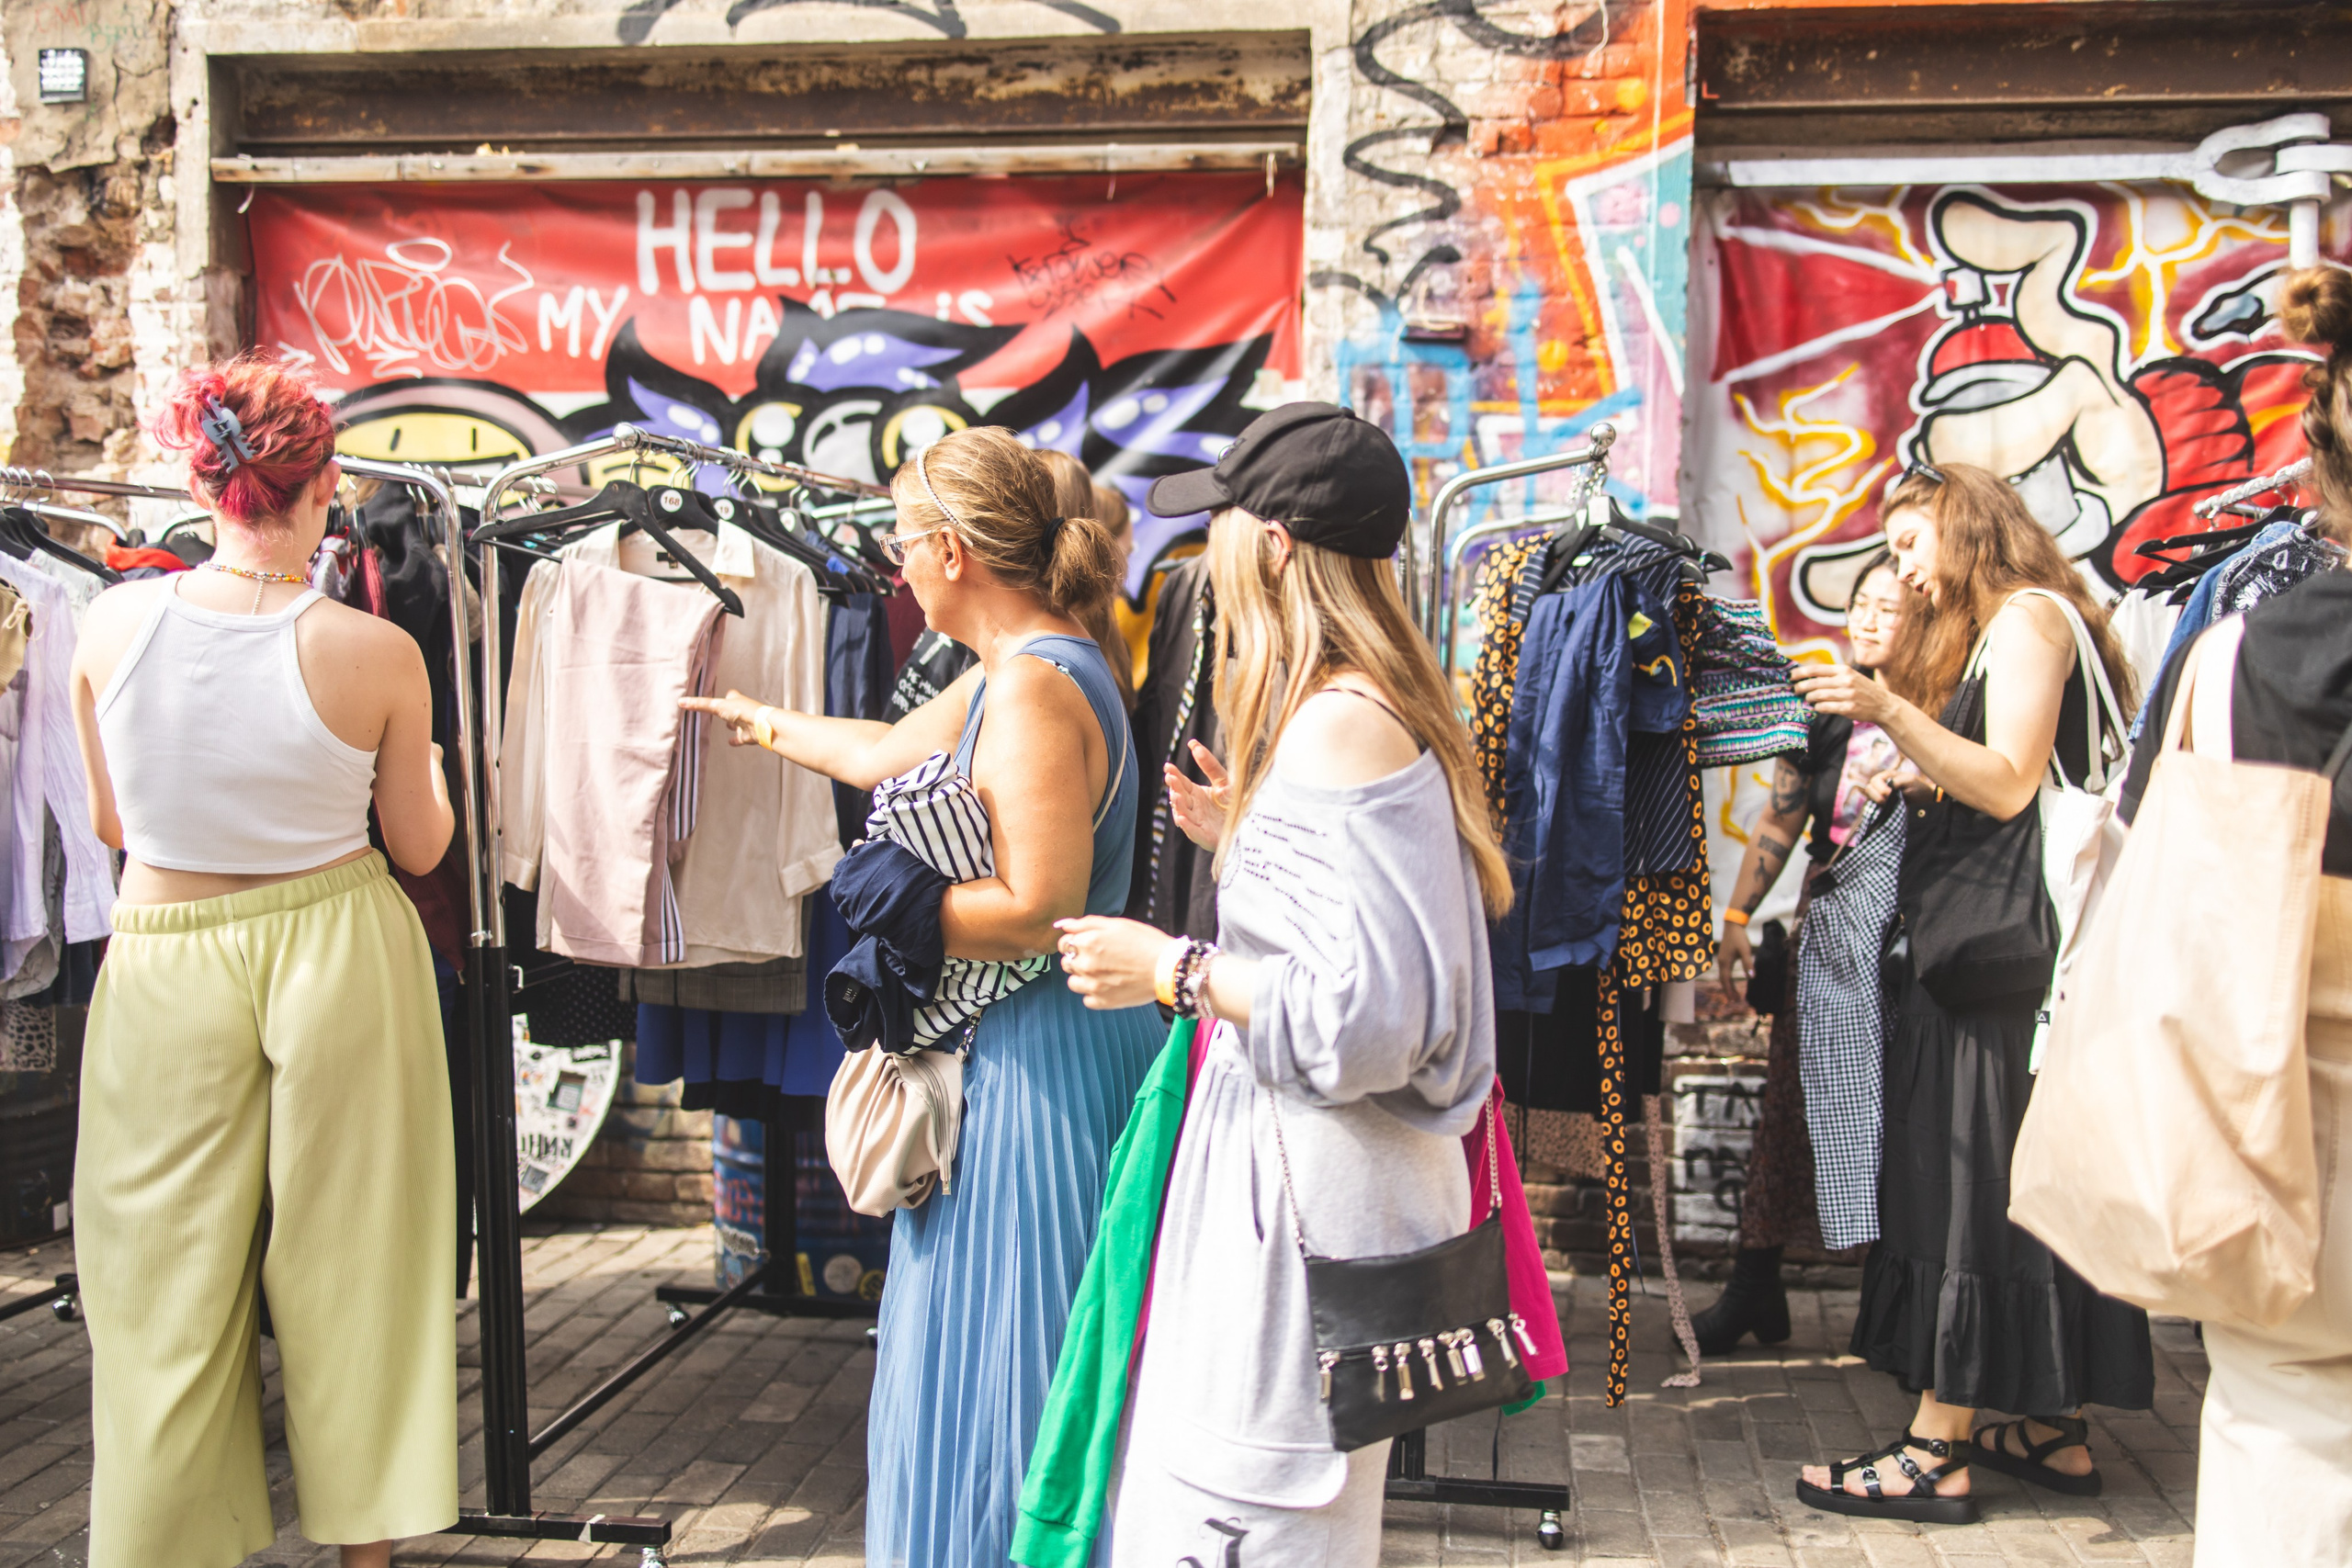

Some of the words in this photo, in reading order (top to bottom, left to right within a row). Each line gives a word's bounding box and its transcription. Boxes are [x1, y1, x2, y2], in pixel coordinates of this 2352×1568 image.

[637, 189, 917, 296] HELLO
[538, 285, 629, 360] MY
[689, 290, 886, 365] NA
[663, 496, 681, 506] 168
